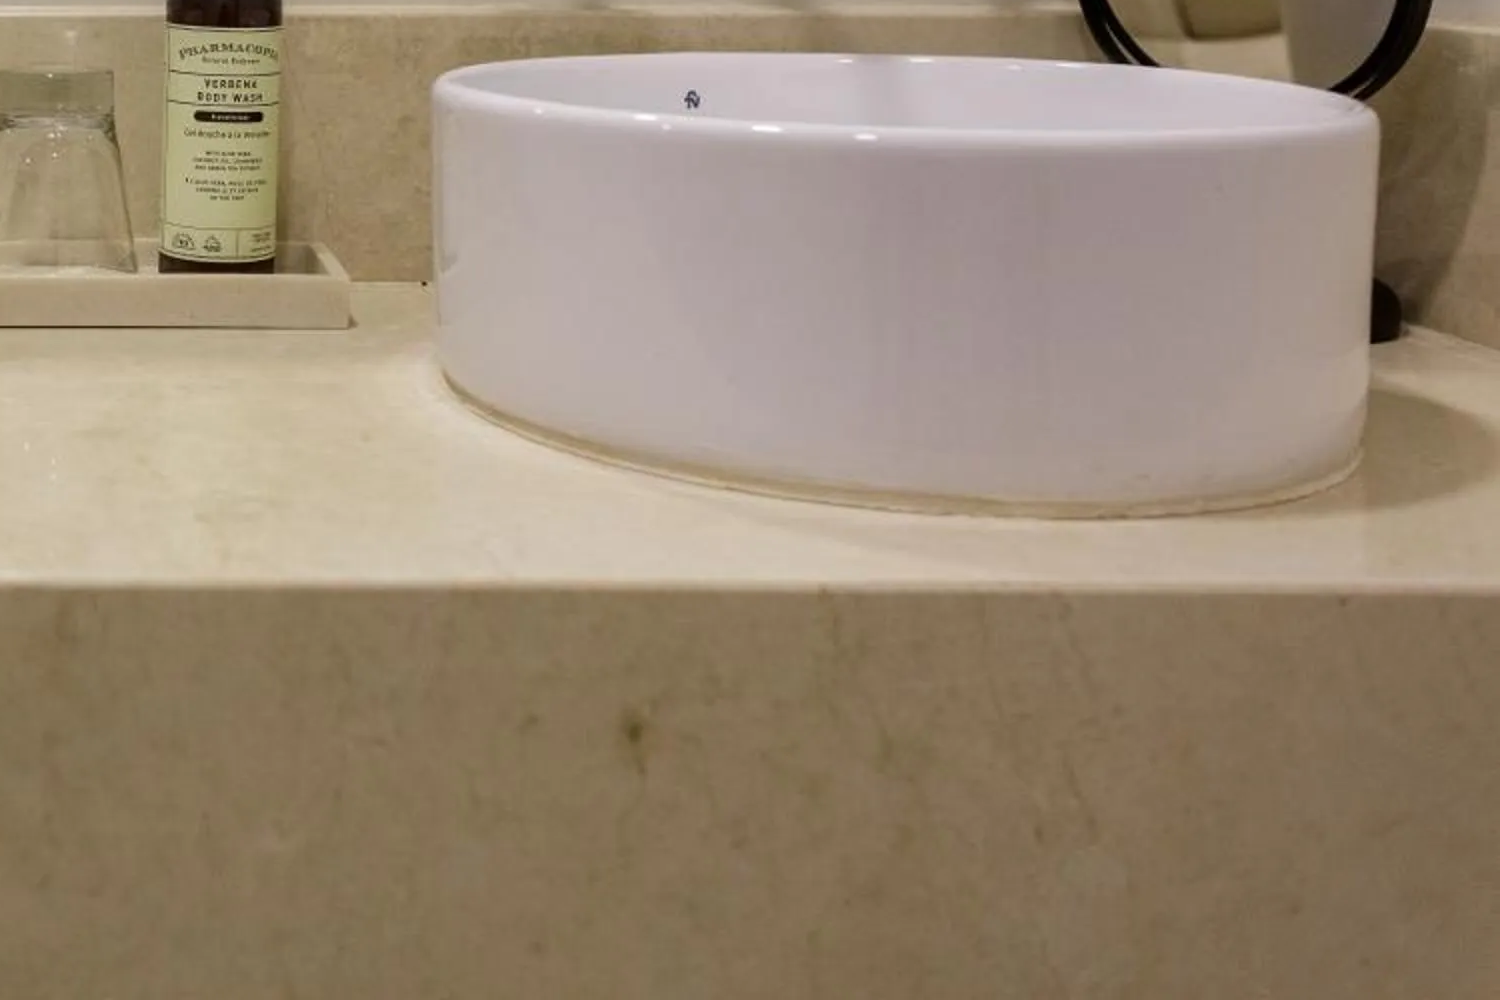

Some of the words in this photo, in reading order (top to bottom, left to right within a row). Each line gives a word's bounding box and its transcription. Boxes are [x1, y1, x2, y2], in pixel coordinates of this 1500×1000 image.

[203, 78, 258, 89] VERBENA
[197, 91, 228, 103] BODY
[232, 92, 263, 103] WASH
